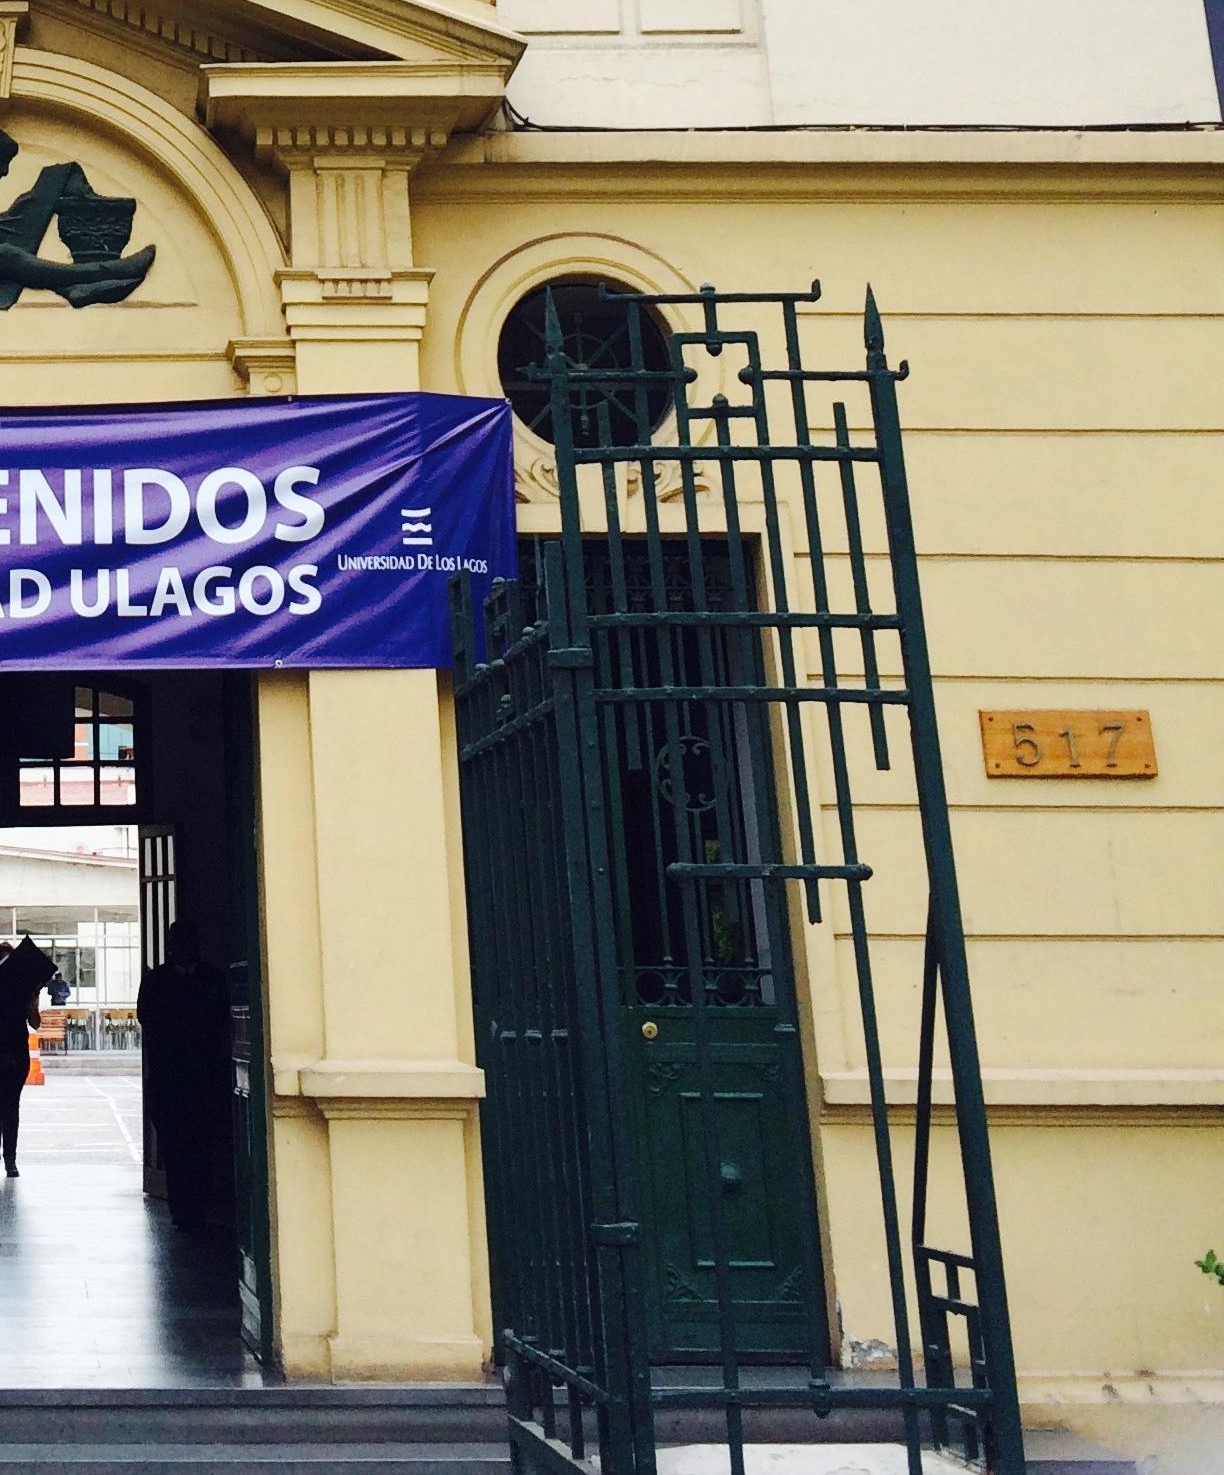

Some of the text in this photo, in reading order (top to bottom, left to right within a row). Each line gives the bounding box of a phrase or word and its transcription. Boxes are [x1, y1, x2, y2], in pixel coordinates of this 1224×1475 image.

[337, 554, 415, 571] UNIVERSIDAD
[417, 553, 433, 570] DE
[436, 554, 456, 571] LOS
[70, 564, 322, 617] ULAGOS
[1013, 721, 1125, 767] 517
